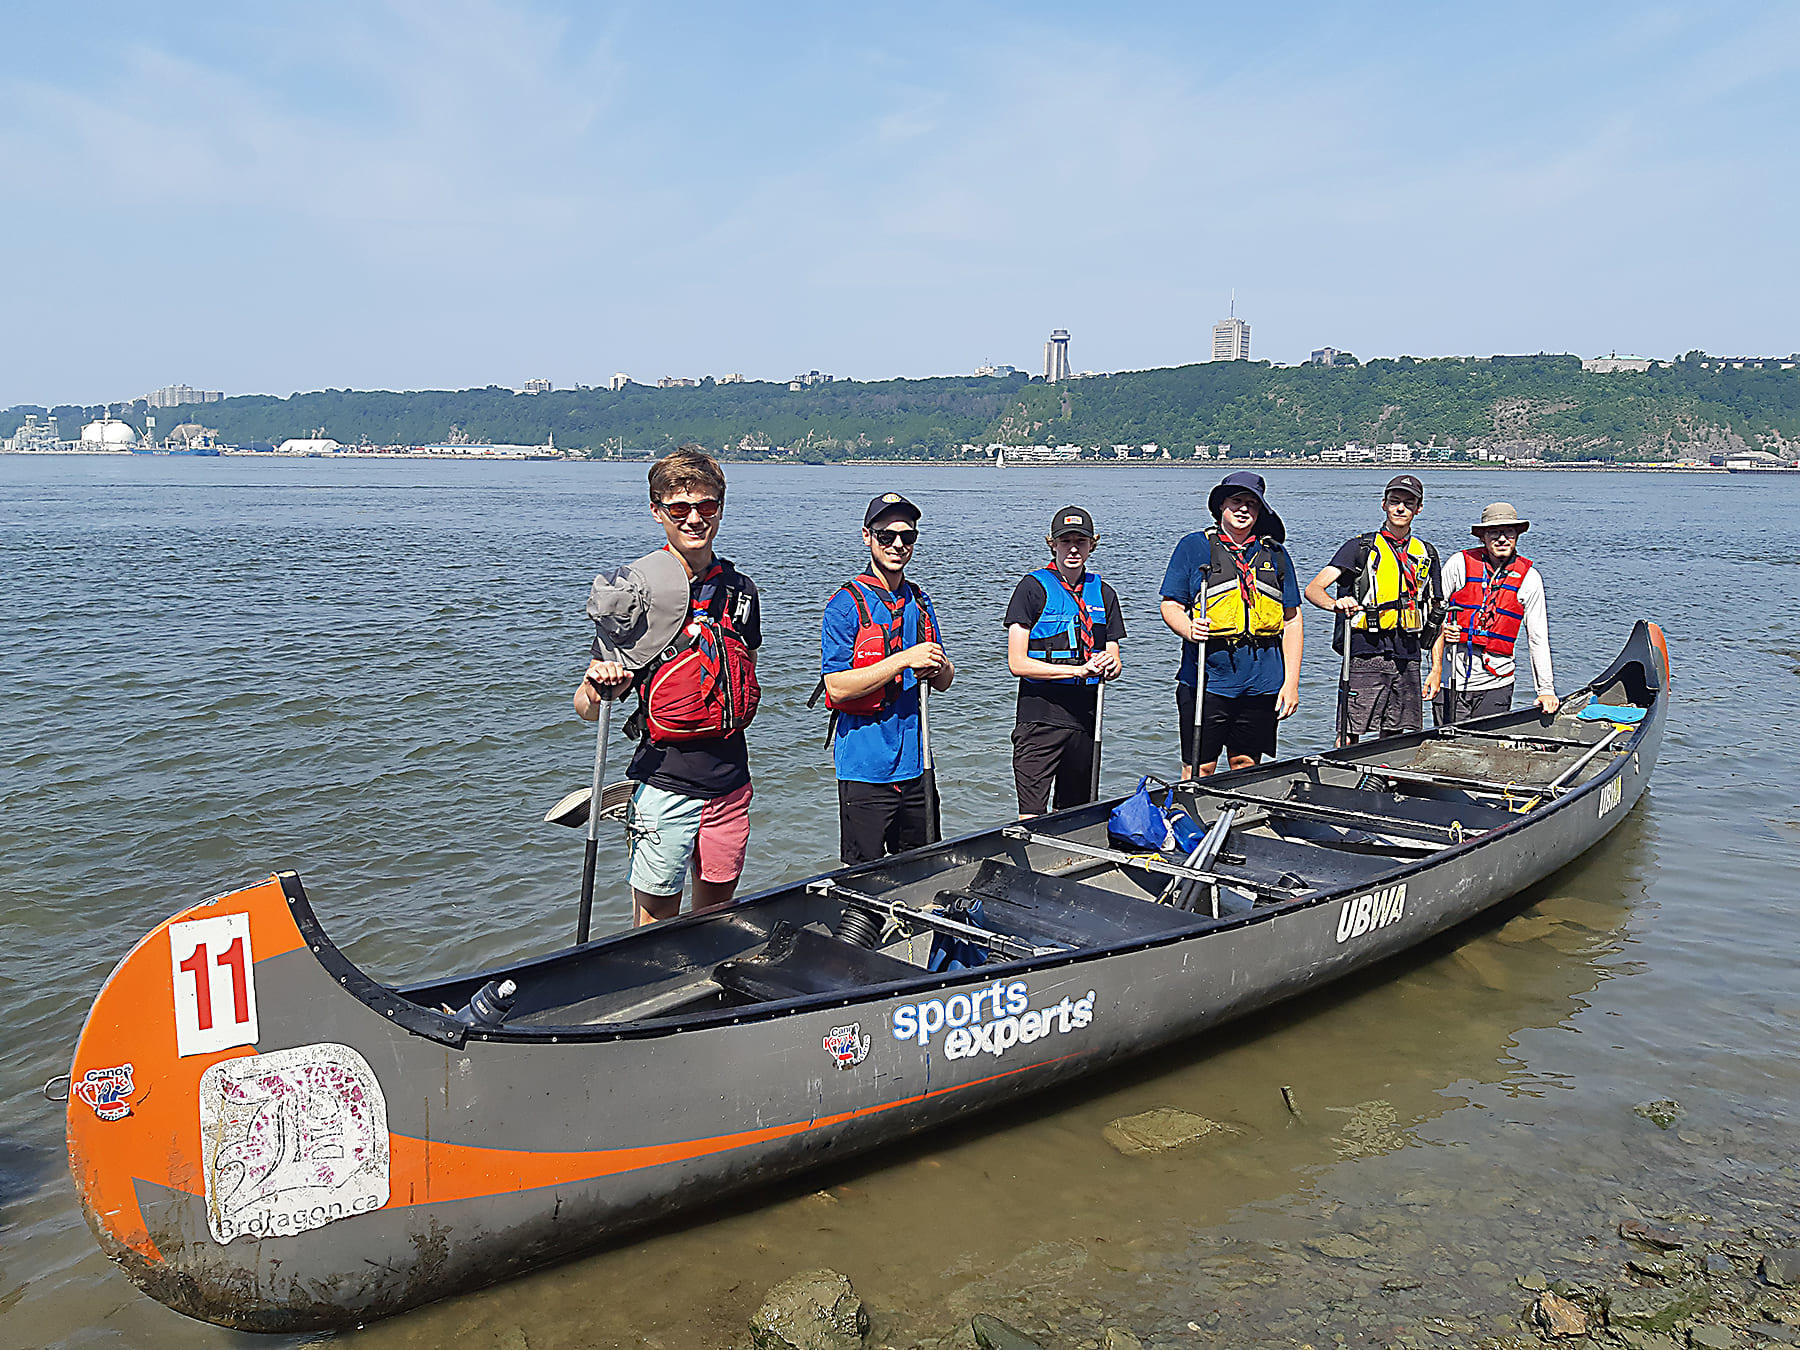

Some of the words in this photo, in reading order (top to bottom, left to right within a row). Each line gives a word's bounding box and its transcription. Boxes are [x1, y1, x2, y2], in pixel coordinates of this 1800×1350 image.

[1335, 883, 1408, 944] UBWA
[179, 936, 250, 1032] 11
[892, 979, 1029, 1046] sports
